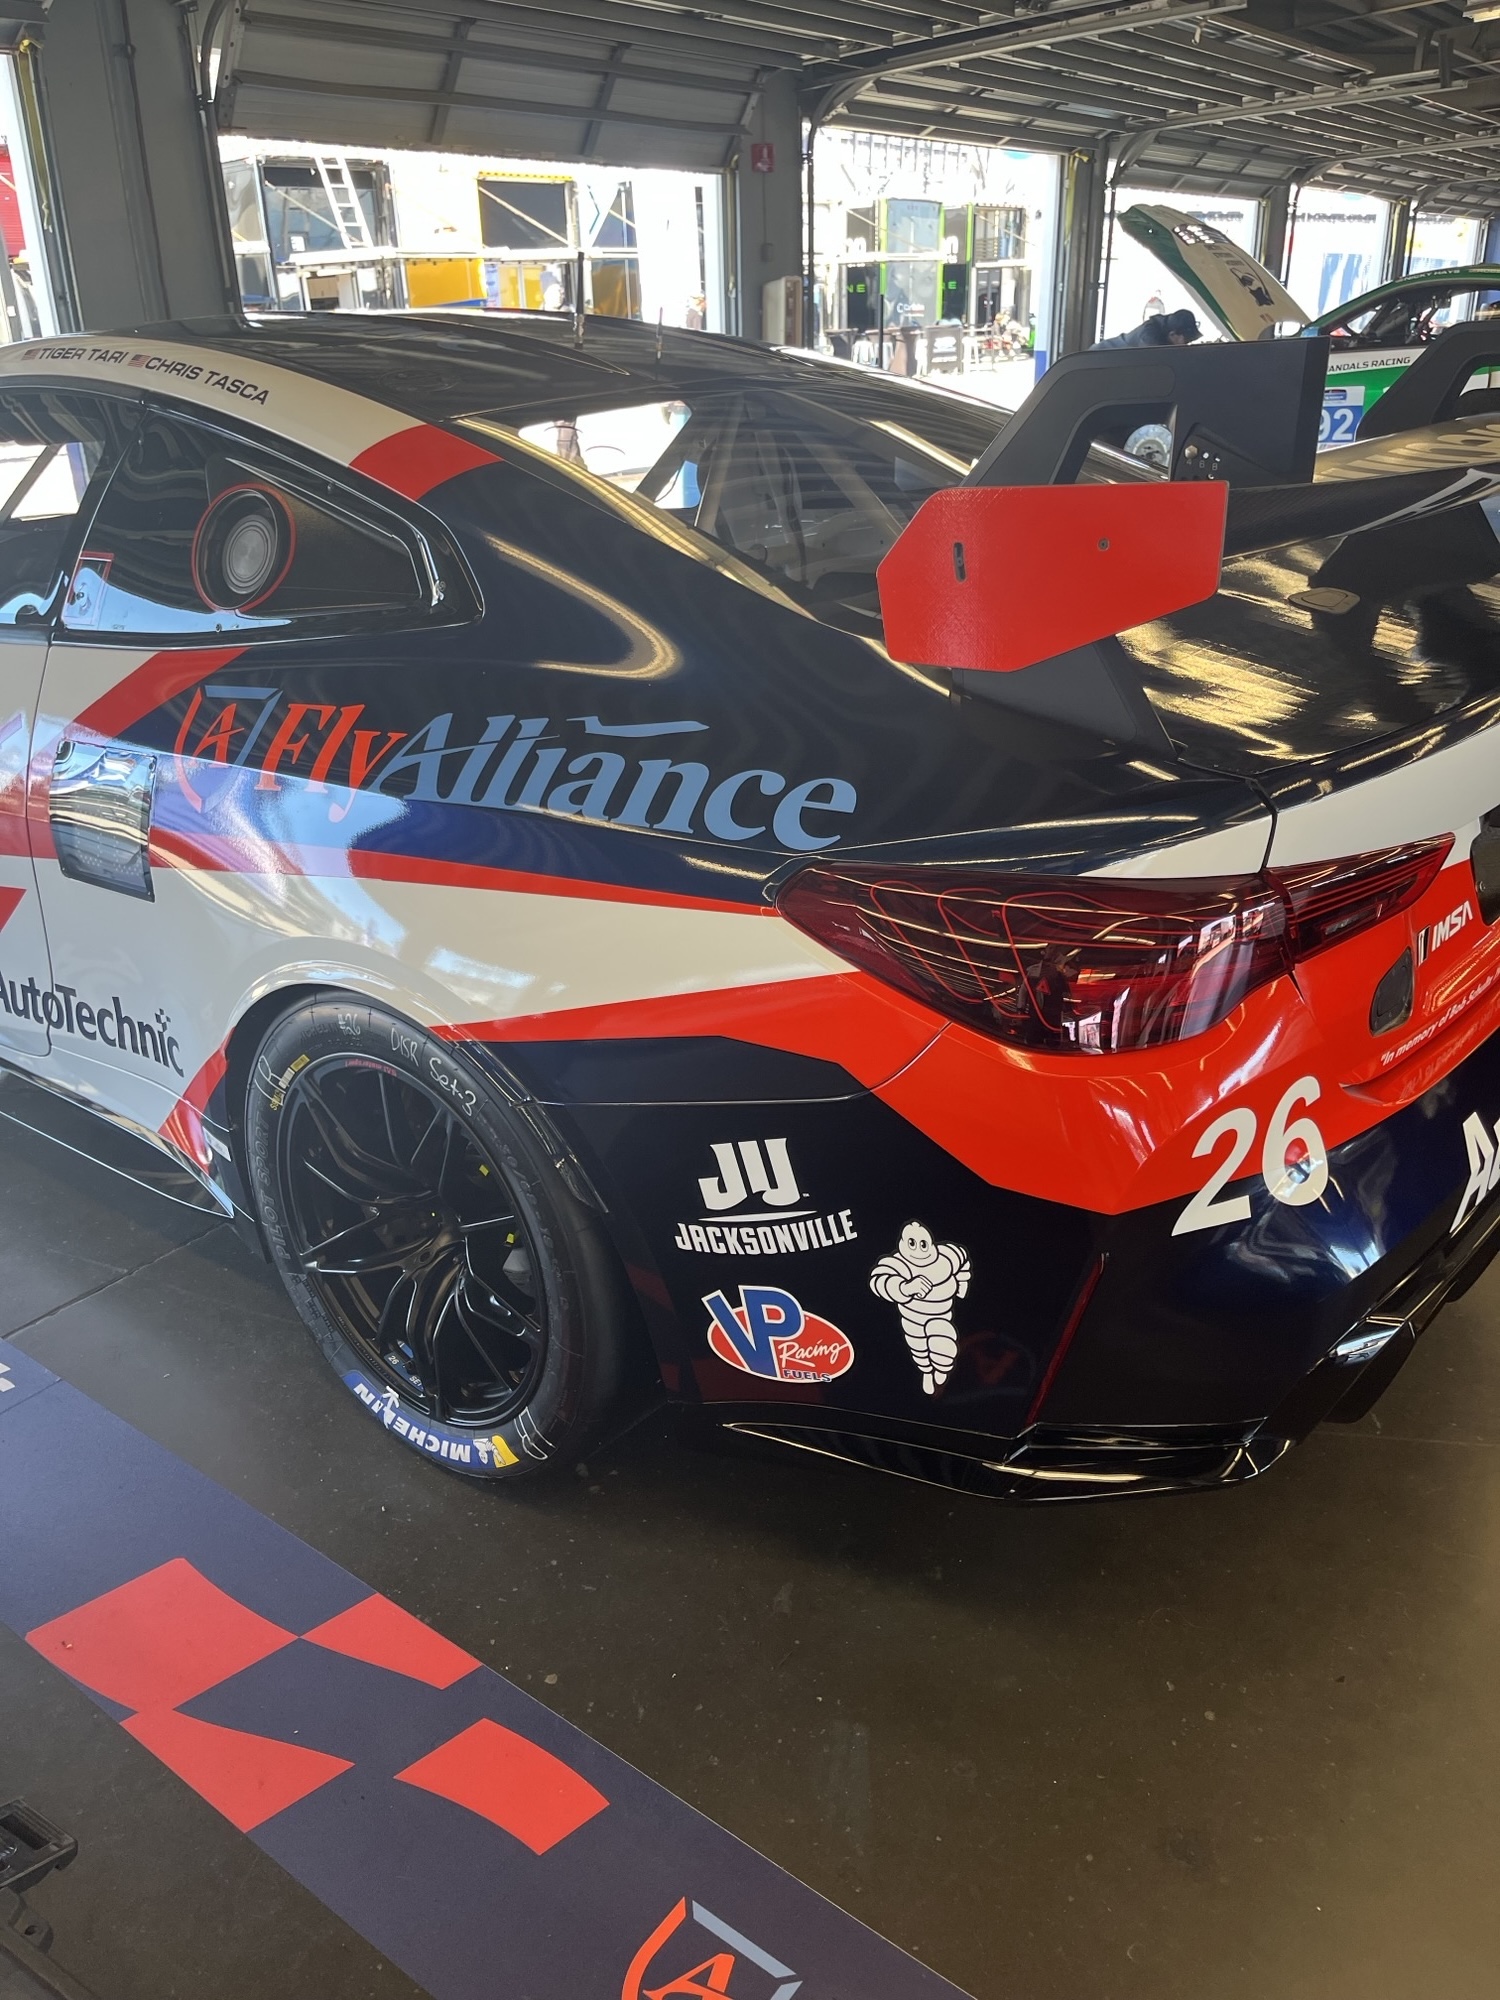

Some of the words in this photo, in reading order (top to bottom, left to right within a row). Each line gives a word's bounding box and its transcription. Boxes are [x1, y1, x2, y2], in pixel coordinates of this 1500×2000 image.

[37, 347, 88, 360] TIGER
[88, 348, 129, 364] TARI
[1371, 356, 1411, 367] RACING
[144, 357, 203, 380] CHRIS
[203, 370, 271, 405] TASCA
[1318, 408, 1354, 441] 92
[256, 703, 857, 851] FlyAlliance
[1431, 900, 1474, 952] IMSA
[1395, 1020, 1439, 1058] memory
[255, 1114, 271, 1186] SPORT
[1171, 1076, 1329, 1237] 26
[698, 1138, 801, 1211] JU
[674, 1208, 858, 1255] JACKSONVILLE
[701, 1284, 805, 1380] VP
[778, 1339, 850, 1368] Racing
[388, 1355, 399, 1365] 26
[782, 1369, 832, 1383] FUELS
[353, 1382, 472, 1464] MICHELIN
